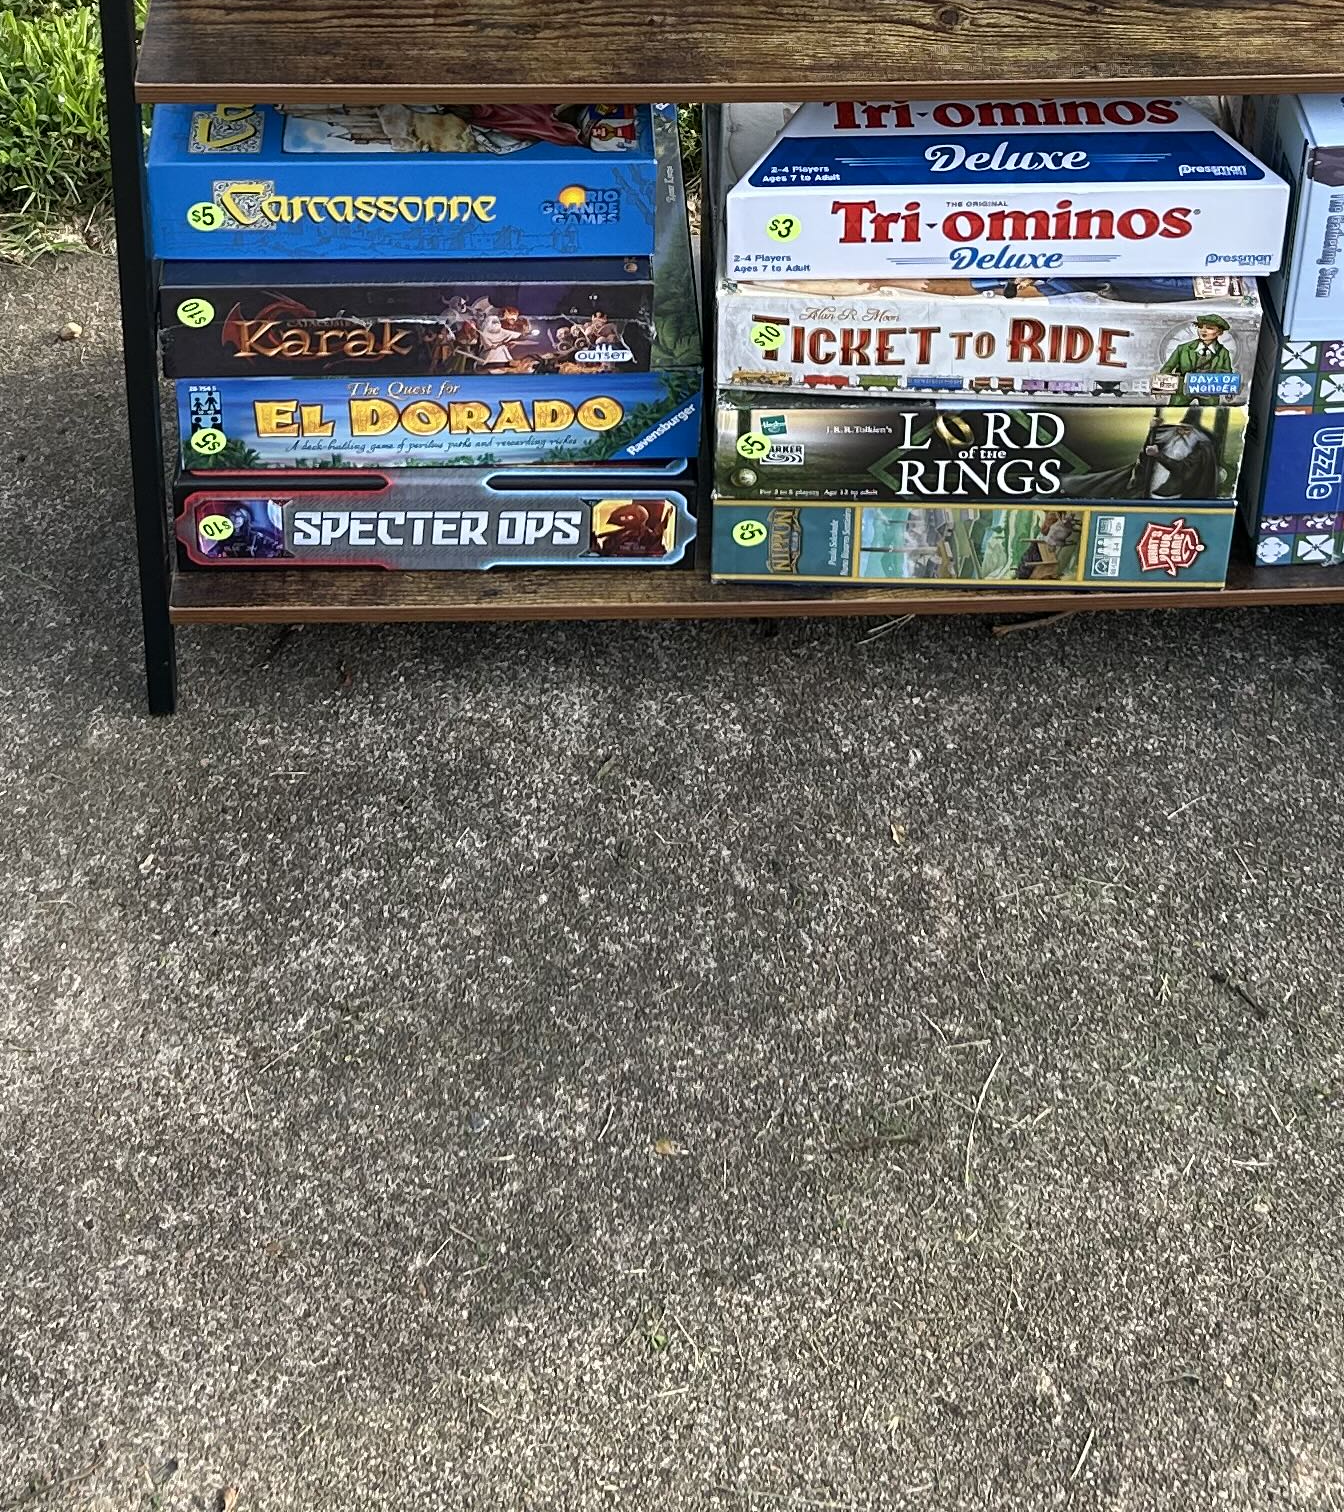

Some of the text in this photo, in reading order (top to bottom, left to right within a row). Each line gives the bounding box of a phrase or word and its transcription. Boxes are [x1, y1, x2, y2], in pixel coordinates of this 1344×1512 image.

[924, 143, 1091, 174] Deluxe
[762, 172, 842, 184] Ages to Adult
[793, 165, 830, 176] Players
[1178, 163, 1248, 177] Pressman
[220, 181, 497, 226] Carcassonne
[542, 201, 619, 216] GRANDE
[191, 206, 215, 227] $5
[551, 213, 618, 226] GAMES
[768, 218, 794, 239] $3
[733, 262, 811, 274] Ages to Adult
[754, 253, 792, 264] Players
[949, 245, 1065, 272] Deluxe
[1204, 251, 1274, 266] Pressman
[231, 319, 413, 359] Karak
[752, 314, 1131, 369] TICKET RIDE
[754, 325, 782, 349] $10
[348, 380, 461, 400] The Quest for
[1190, 375, 1240, 384] DAYS OF
[253, 395, 624, 438] EL DORADO
[625, 402, 697, 457] Ravensburger
[900, 411, 1066, 450] LORD
[739, 436, 766, 458] $5
[958, 447, 977, 460] of
[895, 459, 1062, 496] RINGS
[292, 509, 583, 547] SPECTER OPS
